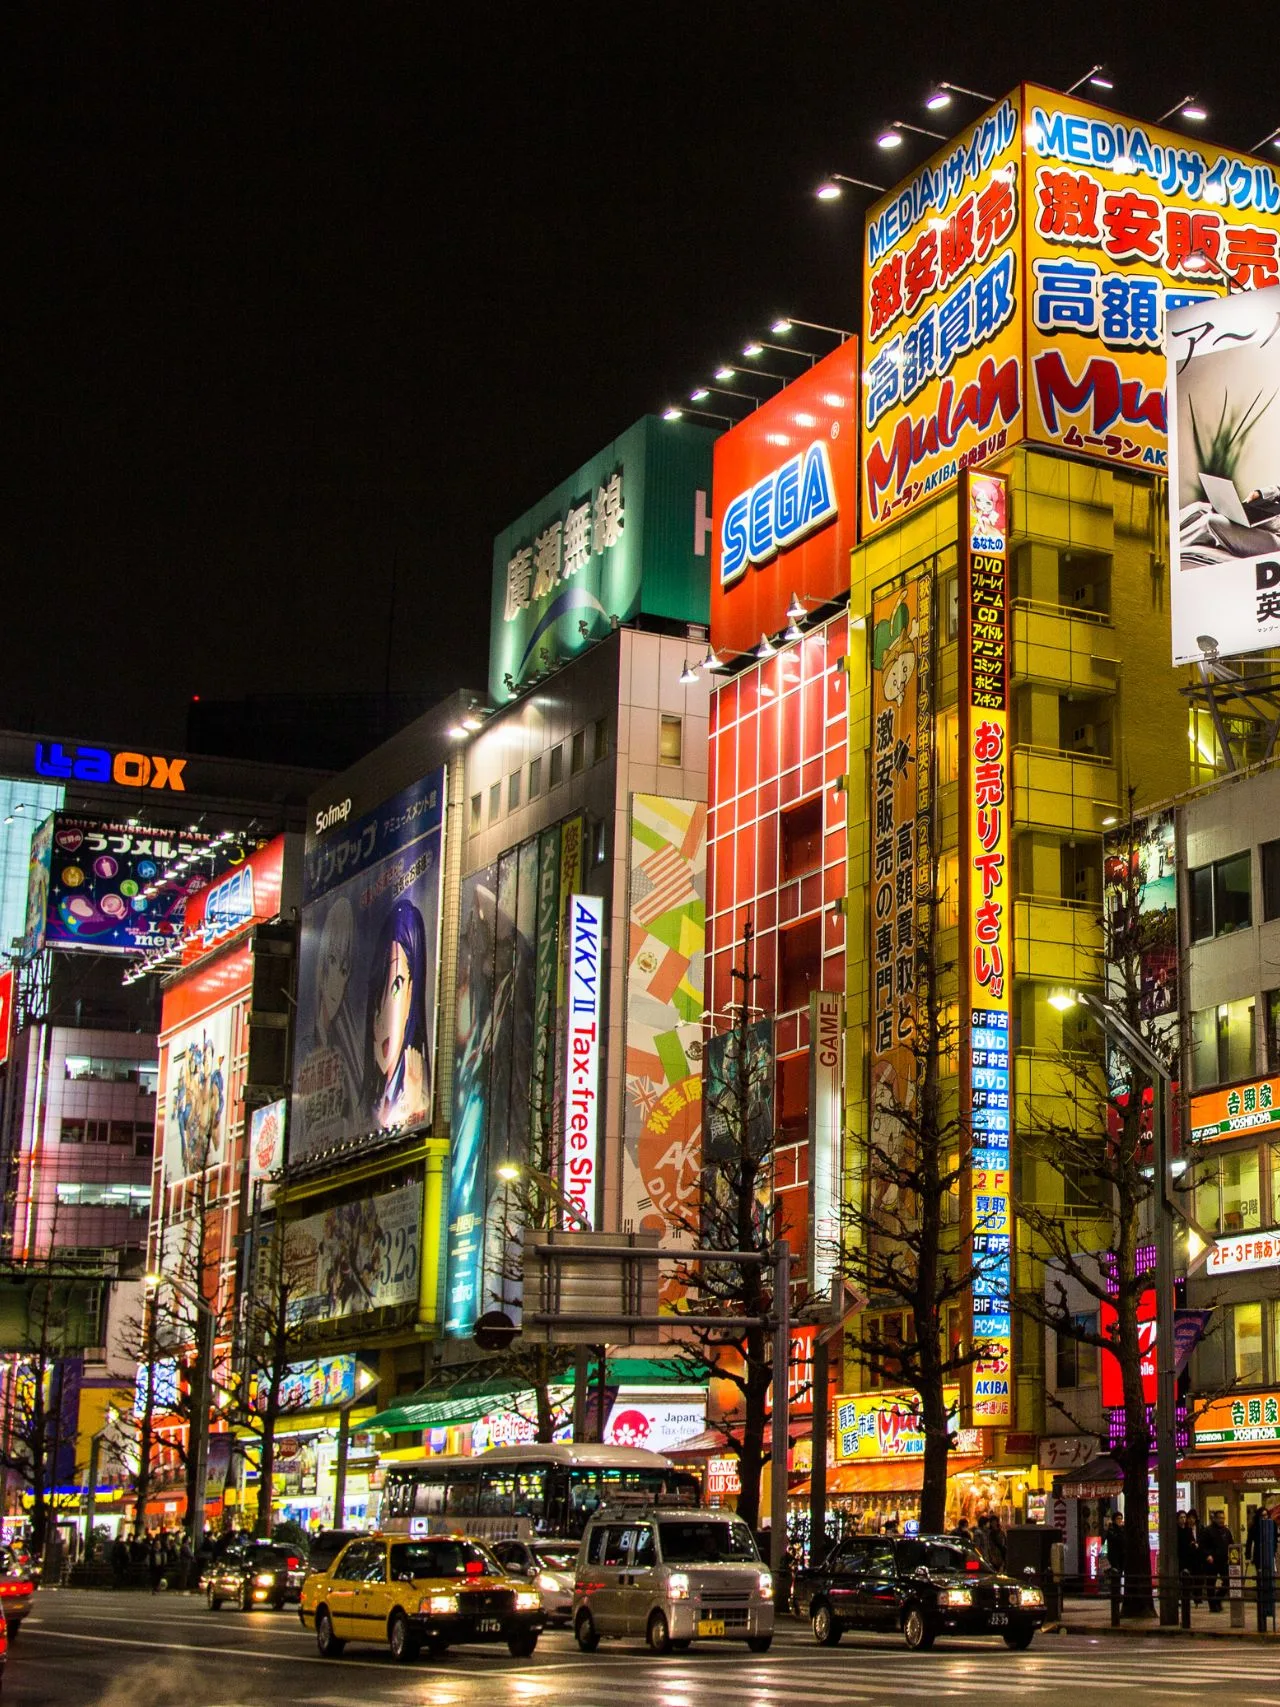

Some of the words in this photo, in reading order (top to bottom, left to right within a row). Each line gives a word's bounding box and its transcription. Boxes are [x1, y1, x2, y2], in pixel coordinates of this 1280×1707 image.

[869, 168, 1015, 338] 激安販売
[867, 249, 1015, 426] 高額買取
[1033, 349, 1167, 438] Mu
[866, 356, 1022, 522] Mulan
[1143, 446, 1168, 468] AK
[721, 441, 837, 584] SEGA
[972, 536, 1004, 552] あなたの
[973, 556, 1003, 575] DVD
[972, 573, 1004, 591] ブルーレイ
[973, 590, 1004, 608] ゲーム
[977, 607, 998, 624] CD
[973, 623, 1003, 641] アイドル
[973, 640, 1004, 658] アニメ
[973, 657, 1002, 675] コミック
[975, 674, 1002, 690] ホビー
[973, 691, 1003, 709] フィギュア
[315, 798, 351, 834] Sofmap
[874, 708, 896, 1056] 激安販売の専門店
[972, 1012, 987, 1025] 6F
[987, 1013, 1008, 1028] 中古
[819, 1002, 839, 1068] GAME
[975, 1035, 1006, 1049] DVD
[972, 1052, 987, 1065] 5F
[987, 1054, 1008, 1068] 中古
[568, 1021, 596, 1150] Tax-free
[975, 1075, 1007, 1089] DVD
[972, 1091, 987, 1105] 4F
[987, 1093, 1008, 1108] 中古
[1229, 1111, 1271, 1131] YOSHINOYA
[987, 1134, 1008, 1148] 中古
[976, 1196, 1006, 1212] 買取
[1240, 1201, 1259, 1218] 3階
[973, 1237, 987, 1250] 1F
[973, 1299, 990, 1313] B1F
[974, 1318, 1009, 1336] PCゲーム
[975, 1380, 1008, 1395] AKIBA
[839, 1403, 856, 1430] 買取
[1234, 1426, 1277, 1441] YOSHINOYA
